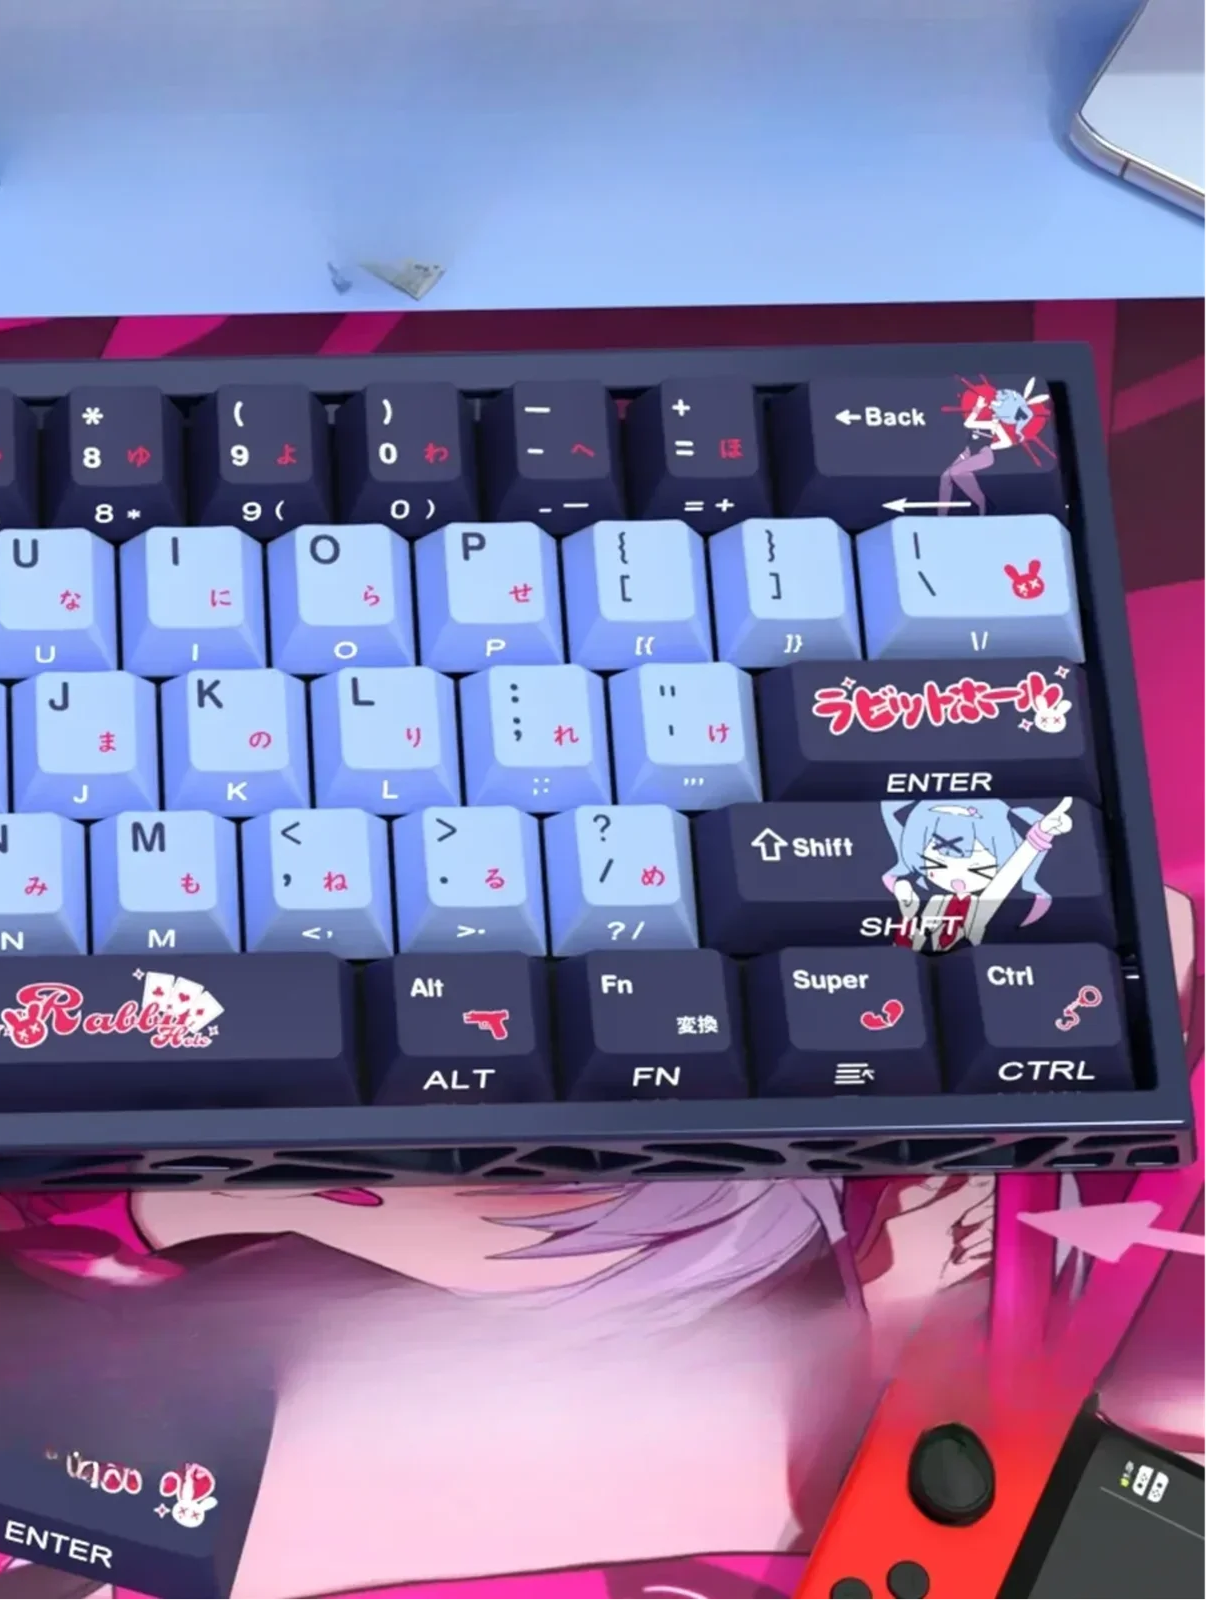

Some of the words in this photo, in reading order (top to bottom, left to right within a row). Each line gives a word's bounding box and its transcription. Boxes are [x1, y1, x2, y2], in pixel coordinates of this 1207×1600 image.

[866, 407, 925, 426] Back
[83, 448, 101, 468] 8
[127, 447, 150, 466] ゆ
[231, 445, 249, 466] 9
[277, 443, 298, 464] よ
[379, 443, 397, 464] 0
[425, 443, 448, 462] わ
[720, 439, 741, 458] ほ
[13, 539, 38, 568] U
[310, 535, 340, 564] O
[462, 532, 485, 561] P
[60, 590, 80, 611] な
[209, 589, 231, 609] に
[362, 585, 381, 606] ら
[510, 585, 531, 603] せ
[36, 646, 55, 663] U
[334, 641, 357, 659] O
[486, 639, 506, 656] P
[49, 682, 69, 711] J
[197, 679, 223, 708] K
[352, 677, 375, 706] L
[99, 732, 114, 752] ま
[249, 730, 273, 749] の
[404, 728, 422, 748] り
[554, 726, 578, 744] れ
[707, 724, 729, 742] け
[228, 782, 246, 800] K
[383, 780, 398, 799] L
[887, 773, 992, 792] ENTER
[74, 785, 88, 803] J
[132, 822, 165, 852] M
[793, 838, 852, 857] Shift
[181, 874, 200, 895] も
[324, 872, 348, 891] ね
[486, 868, 505, 890] る
[641, 867, 665, 885] め
[25, 877, 47, 895] み
[860, 917, 962, 936] SHIFT
[1, 932, 23, 950] N
[149, 929, 175, 948] M
[602, 975, 632, 993] Fn
[793, 970, 868, 993] Super
[988, 966, 1033, 985] Ctrl
[411, 978, 443, 997] Alt
[16, 982, 193, 1036] Rabbit
[677, 1015, 717, 1034] 変換
[424, 1070, 495, 1089] ALT
[633, 1067, 680, 1086] FN
[999, 1061, 1094, 1080] CTRL
[5, 1521, 112, 1568] ENTER
